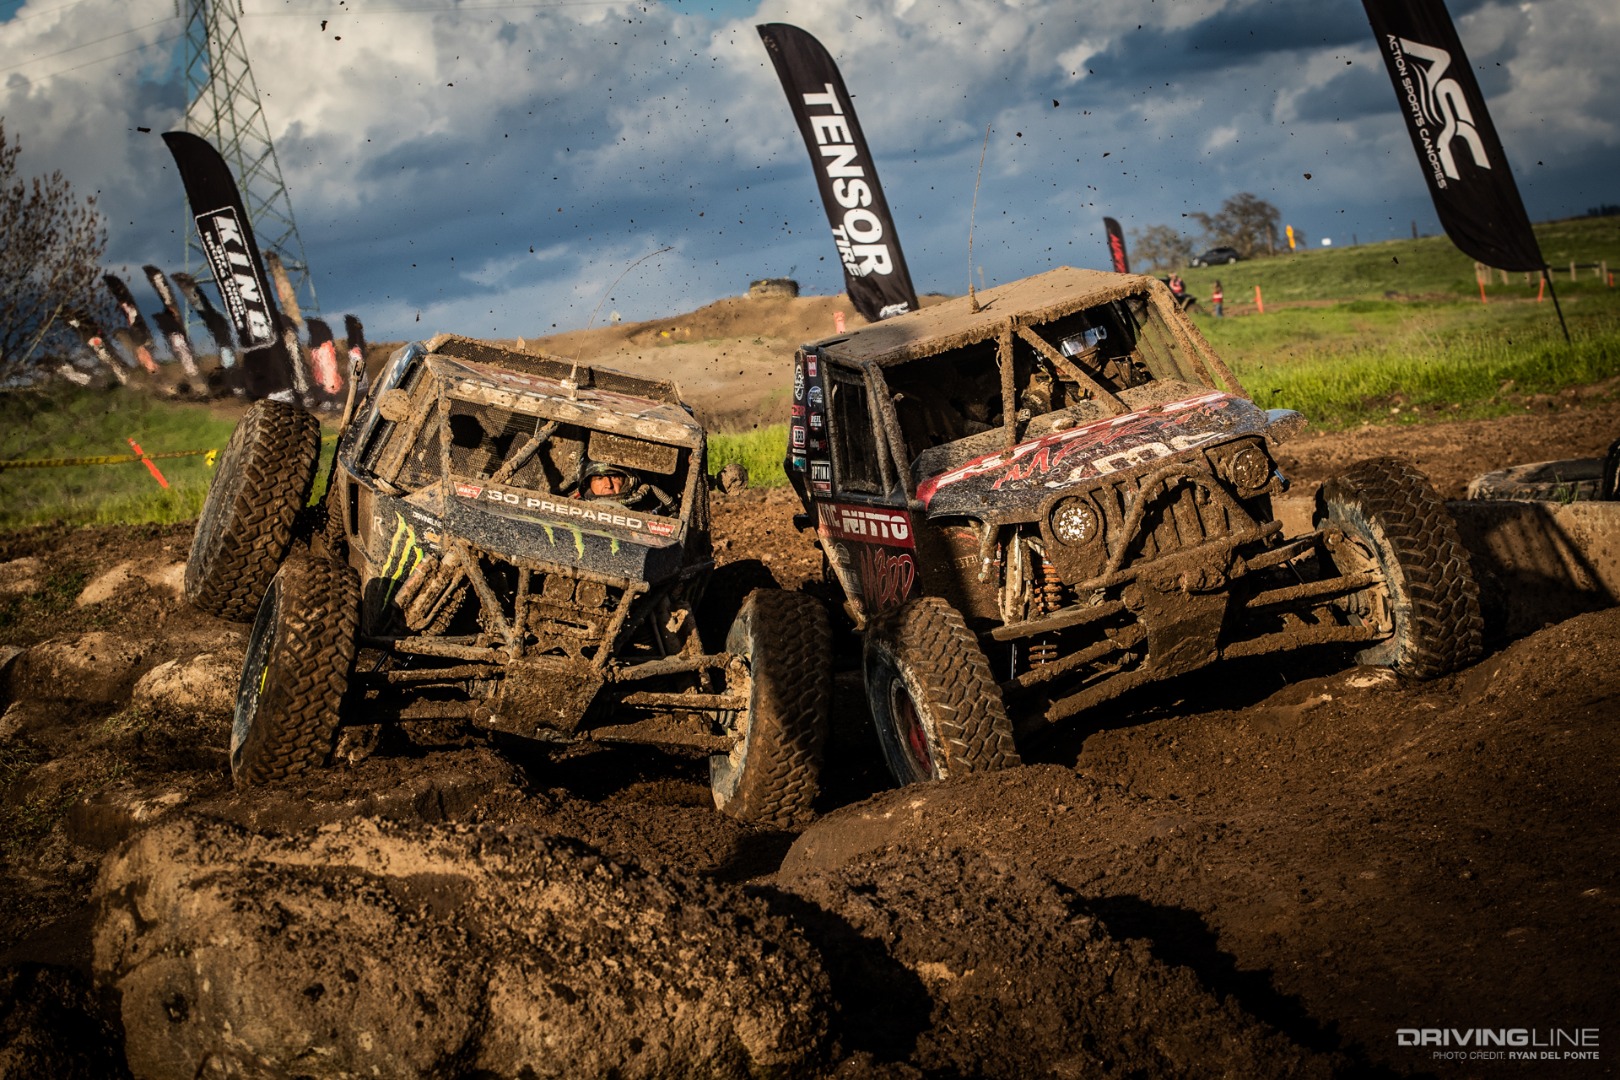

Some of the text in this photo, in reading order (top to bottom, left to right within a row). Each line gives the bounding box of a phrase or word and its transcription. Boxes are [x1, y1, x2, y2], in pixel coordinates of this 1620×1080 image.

[1386, 34, 1447, 189] ACTION SPORTS CANOPIES
[1399, 37, 1491, 180] ASC
[802, 82, 893, 276] TENSOR
[214, 217, 270, 337] KING
[831, 223, 865, 278] TIRE
[526, 497, 643, 529] PREPARED
[841, 509, 909, 540] NITTO
